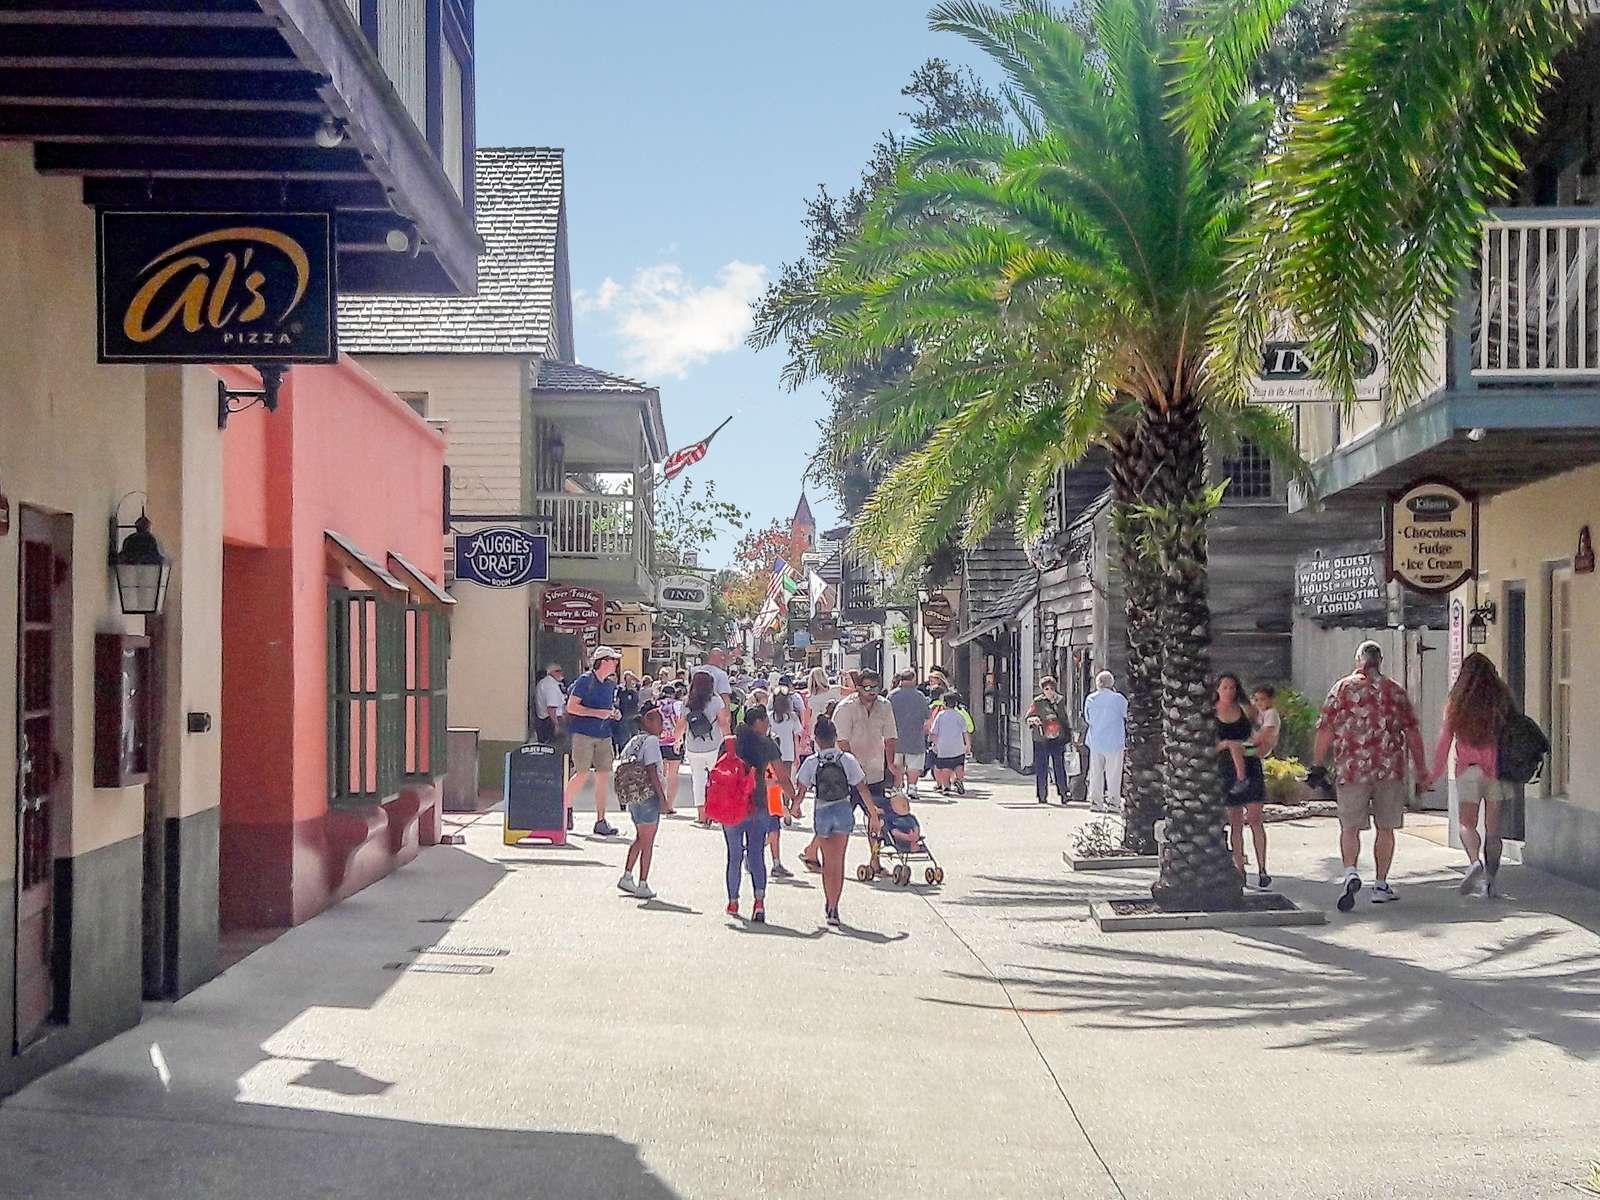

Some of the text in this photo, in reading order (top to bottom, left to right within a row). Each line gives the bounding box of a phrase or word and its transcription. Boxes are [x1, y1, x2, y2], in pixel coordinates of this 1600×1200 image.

[223, 333, 291, 344] PIZZA
[1403, 526, 1466, 539] Chocolates
[1418, 541, 1450, 557] Fudge
[479, 554, 525, 577] DRAFT
[1312, 555, 1371, 571] THE OLDEST
[1406, 557, 1463, 570] Ice Cream
[1300, 566, 1375, 583] WOOD SCHOOL
[1301, 580, 1333, 594] HOUSE
[1352, 576, 1377, 589] USA
[545, 588, 600, 603] Silver Feather
[670, 590, 698, 600] INN
[1322, 588, 1379, 603] AUGUSTINE
[546, 609, 573, 619] Jewelry
[581, 609, 599, 618] Gifts
[1317, 601, 1362, 615] FLORIDA
[603, 618, 621, 634] Go
